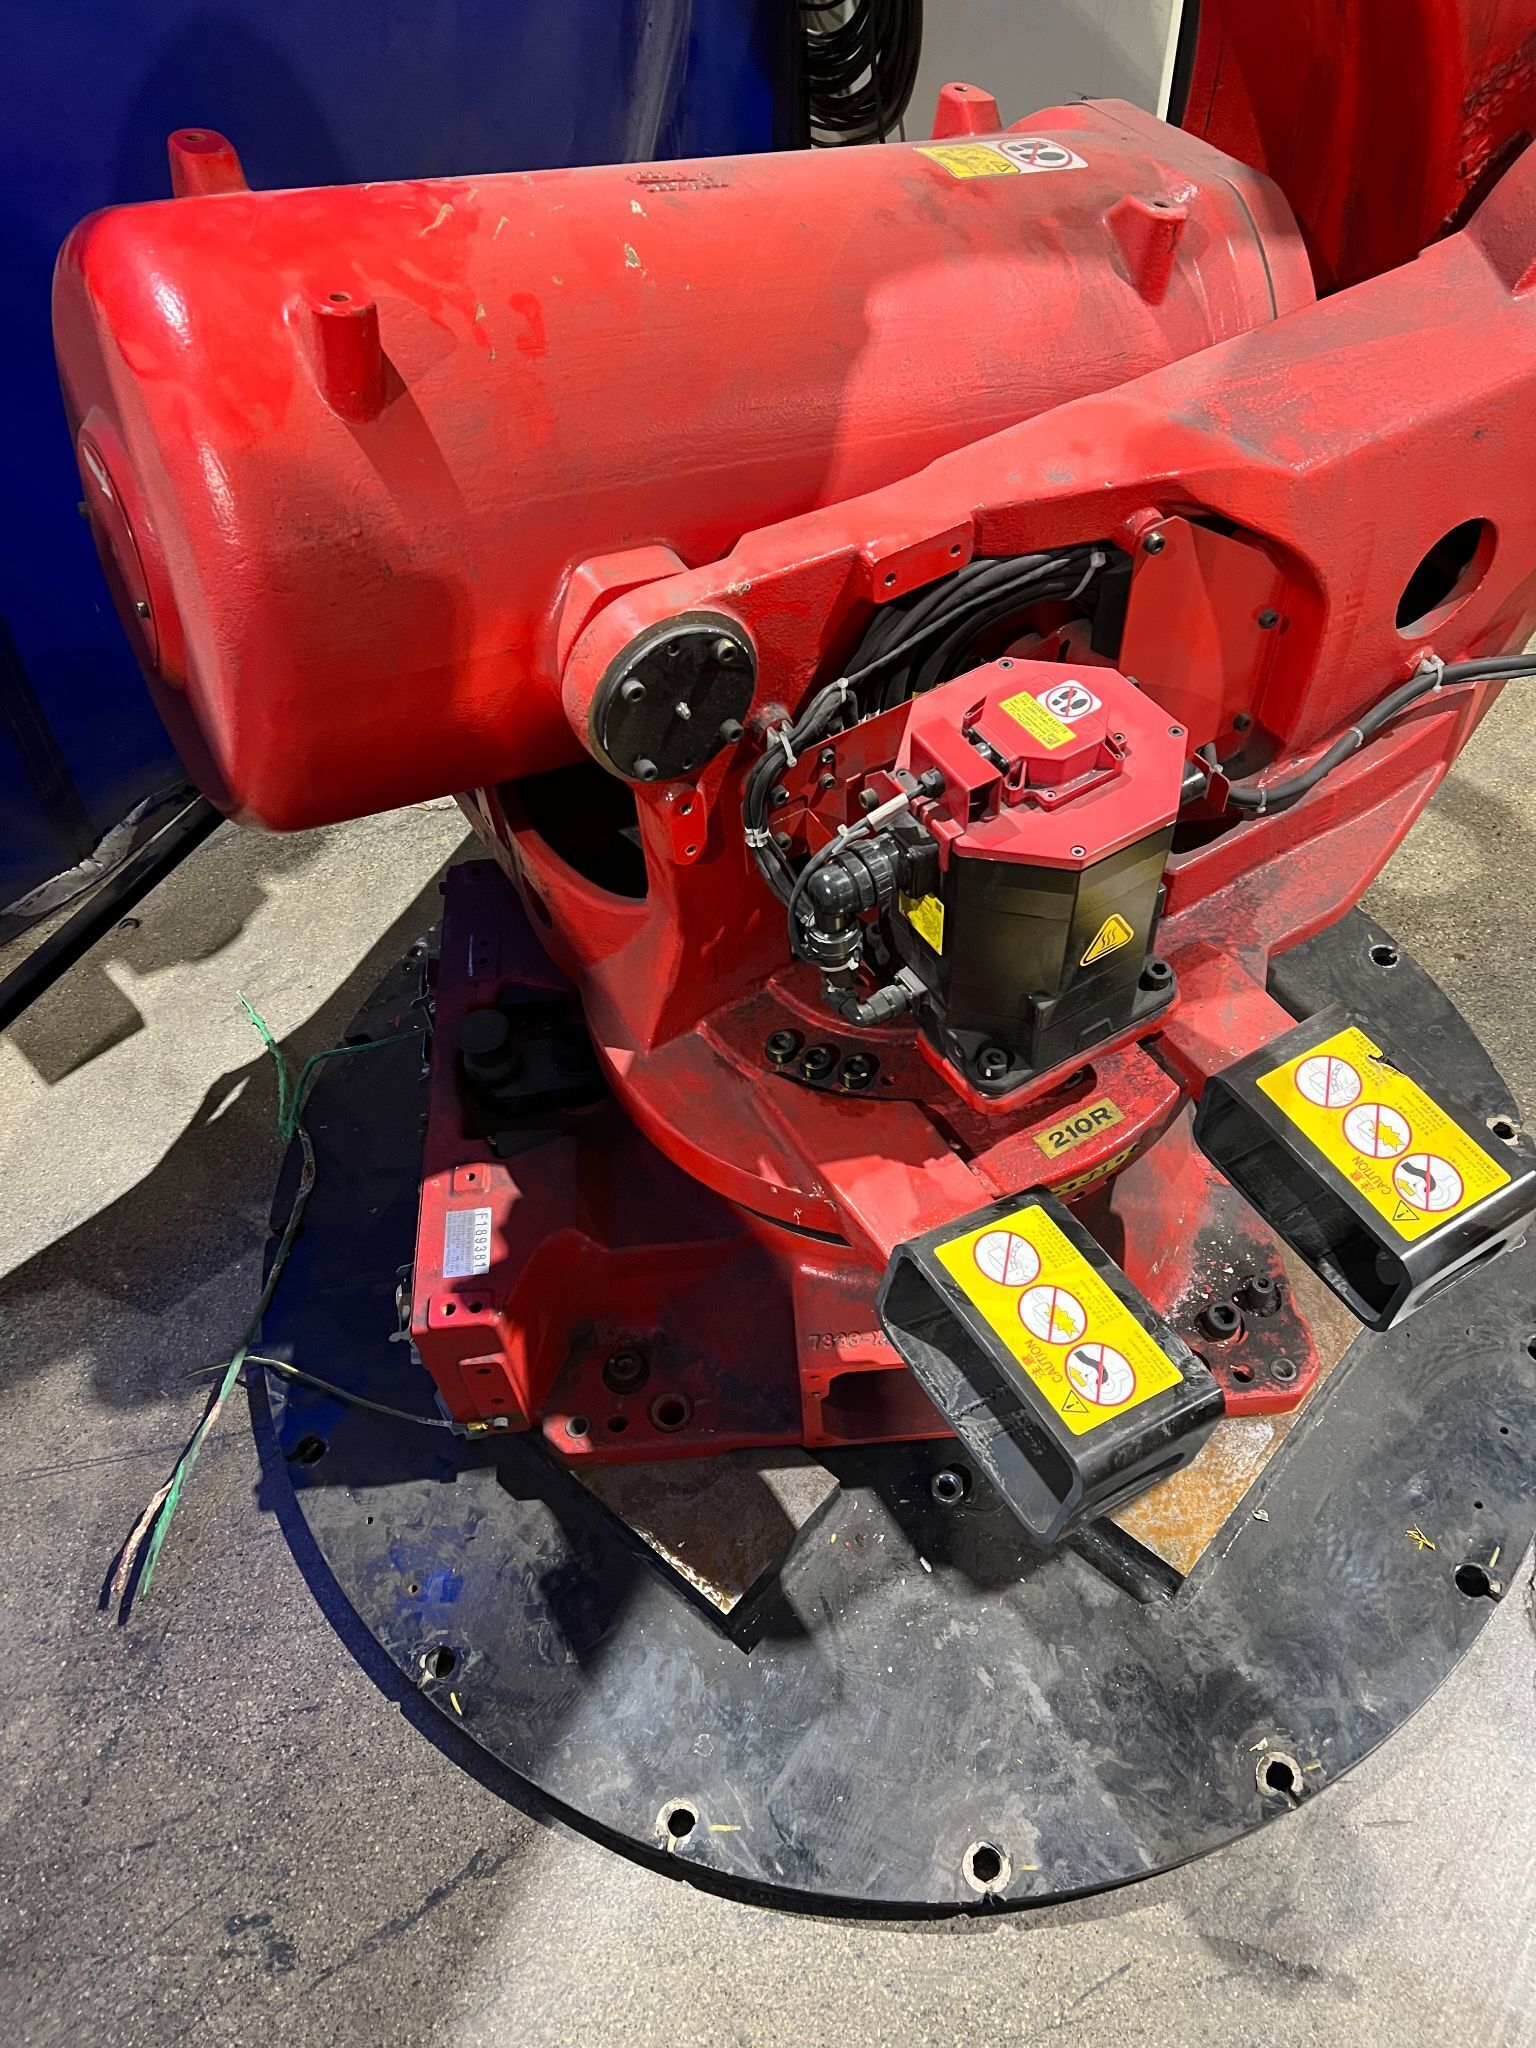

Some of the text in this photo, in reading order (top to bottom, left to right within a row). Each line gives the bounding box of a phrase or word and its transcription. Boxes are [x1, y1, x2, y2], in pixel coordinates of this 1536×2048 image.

[1048, 1106, 1114, 1150] 210R
[1352, 1156, 1392, 1195] CAUTION
[473, 1212, 488, 1268] F189381
[1025, 1339, 1063, 1383] CAUTION
